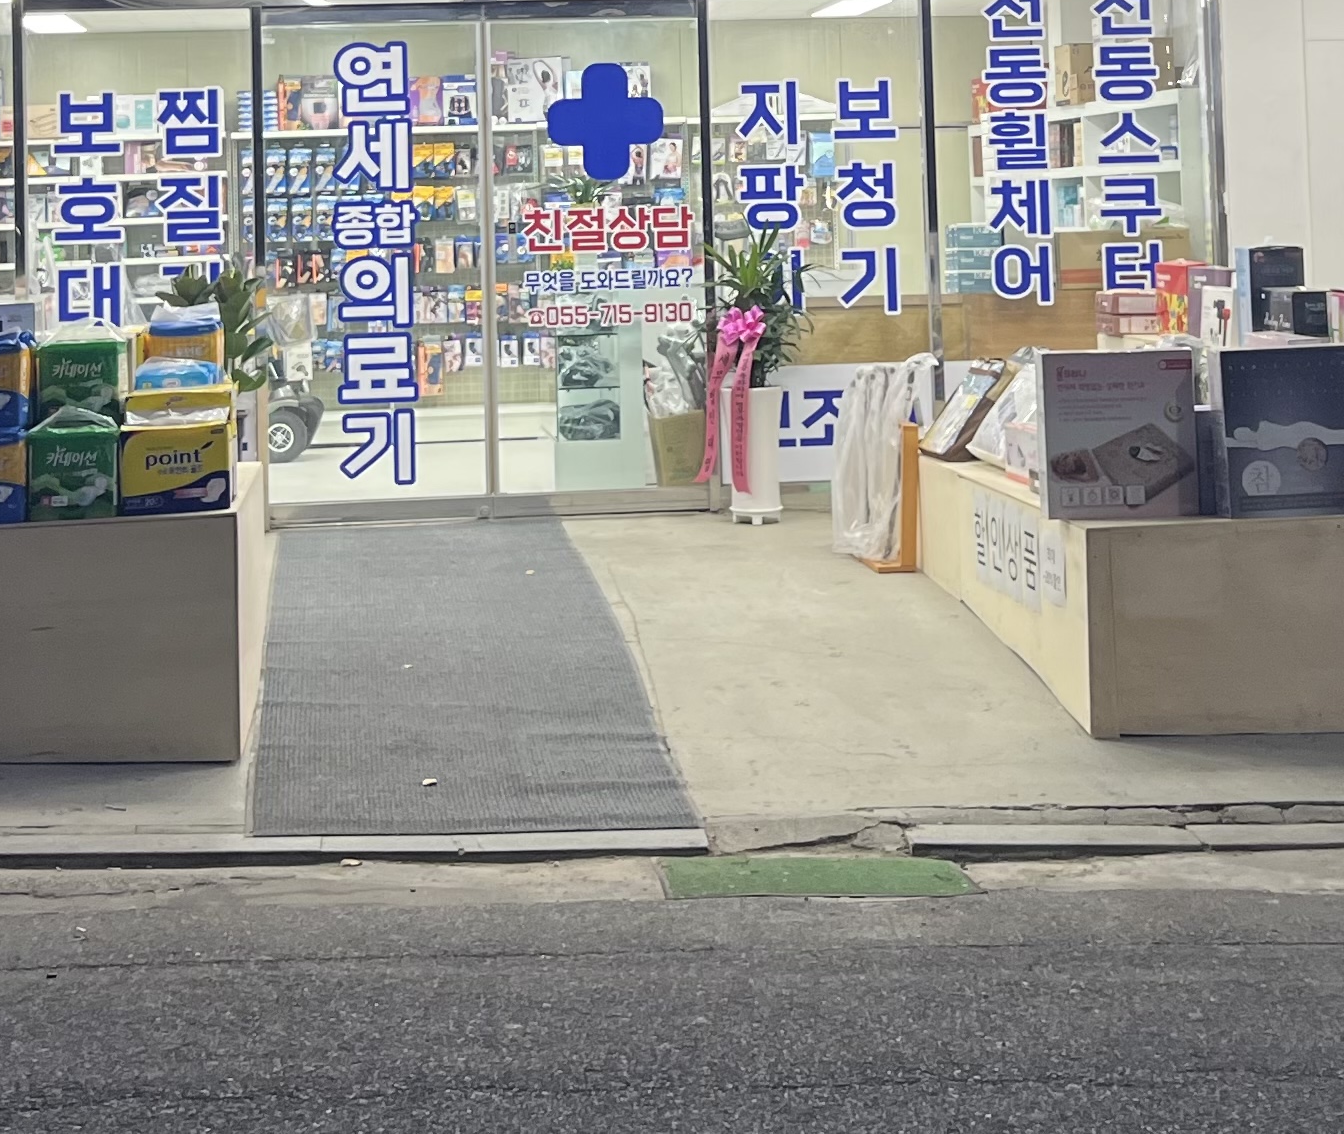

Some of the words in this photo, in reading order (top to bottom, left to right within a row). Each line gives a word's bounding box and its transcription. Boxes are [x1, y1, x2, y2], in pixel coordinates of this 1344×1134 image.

[157, 88, 223, 286] 찜질
[833, 80, 899, 312] 보청기
[53, 92, 124, 326] 보호대
[523, 205, 694, 253] 친절상담
[525, 271, 576, 293] 무엇을
[580, 268, 694, 291] 도와드릴까요?
[545, 302, 692, 326] 055-715-9130
[46, 445, 99, 467] 카네이션
[145, 448, 203, 470] point
